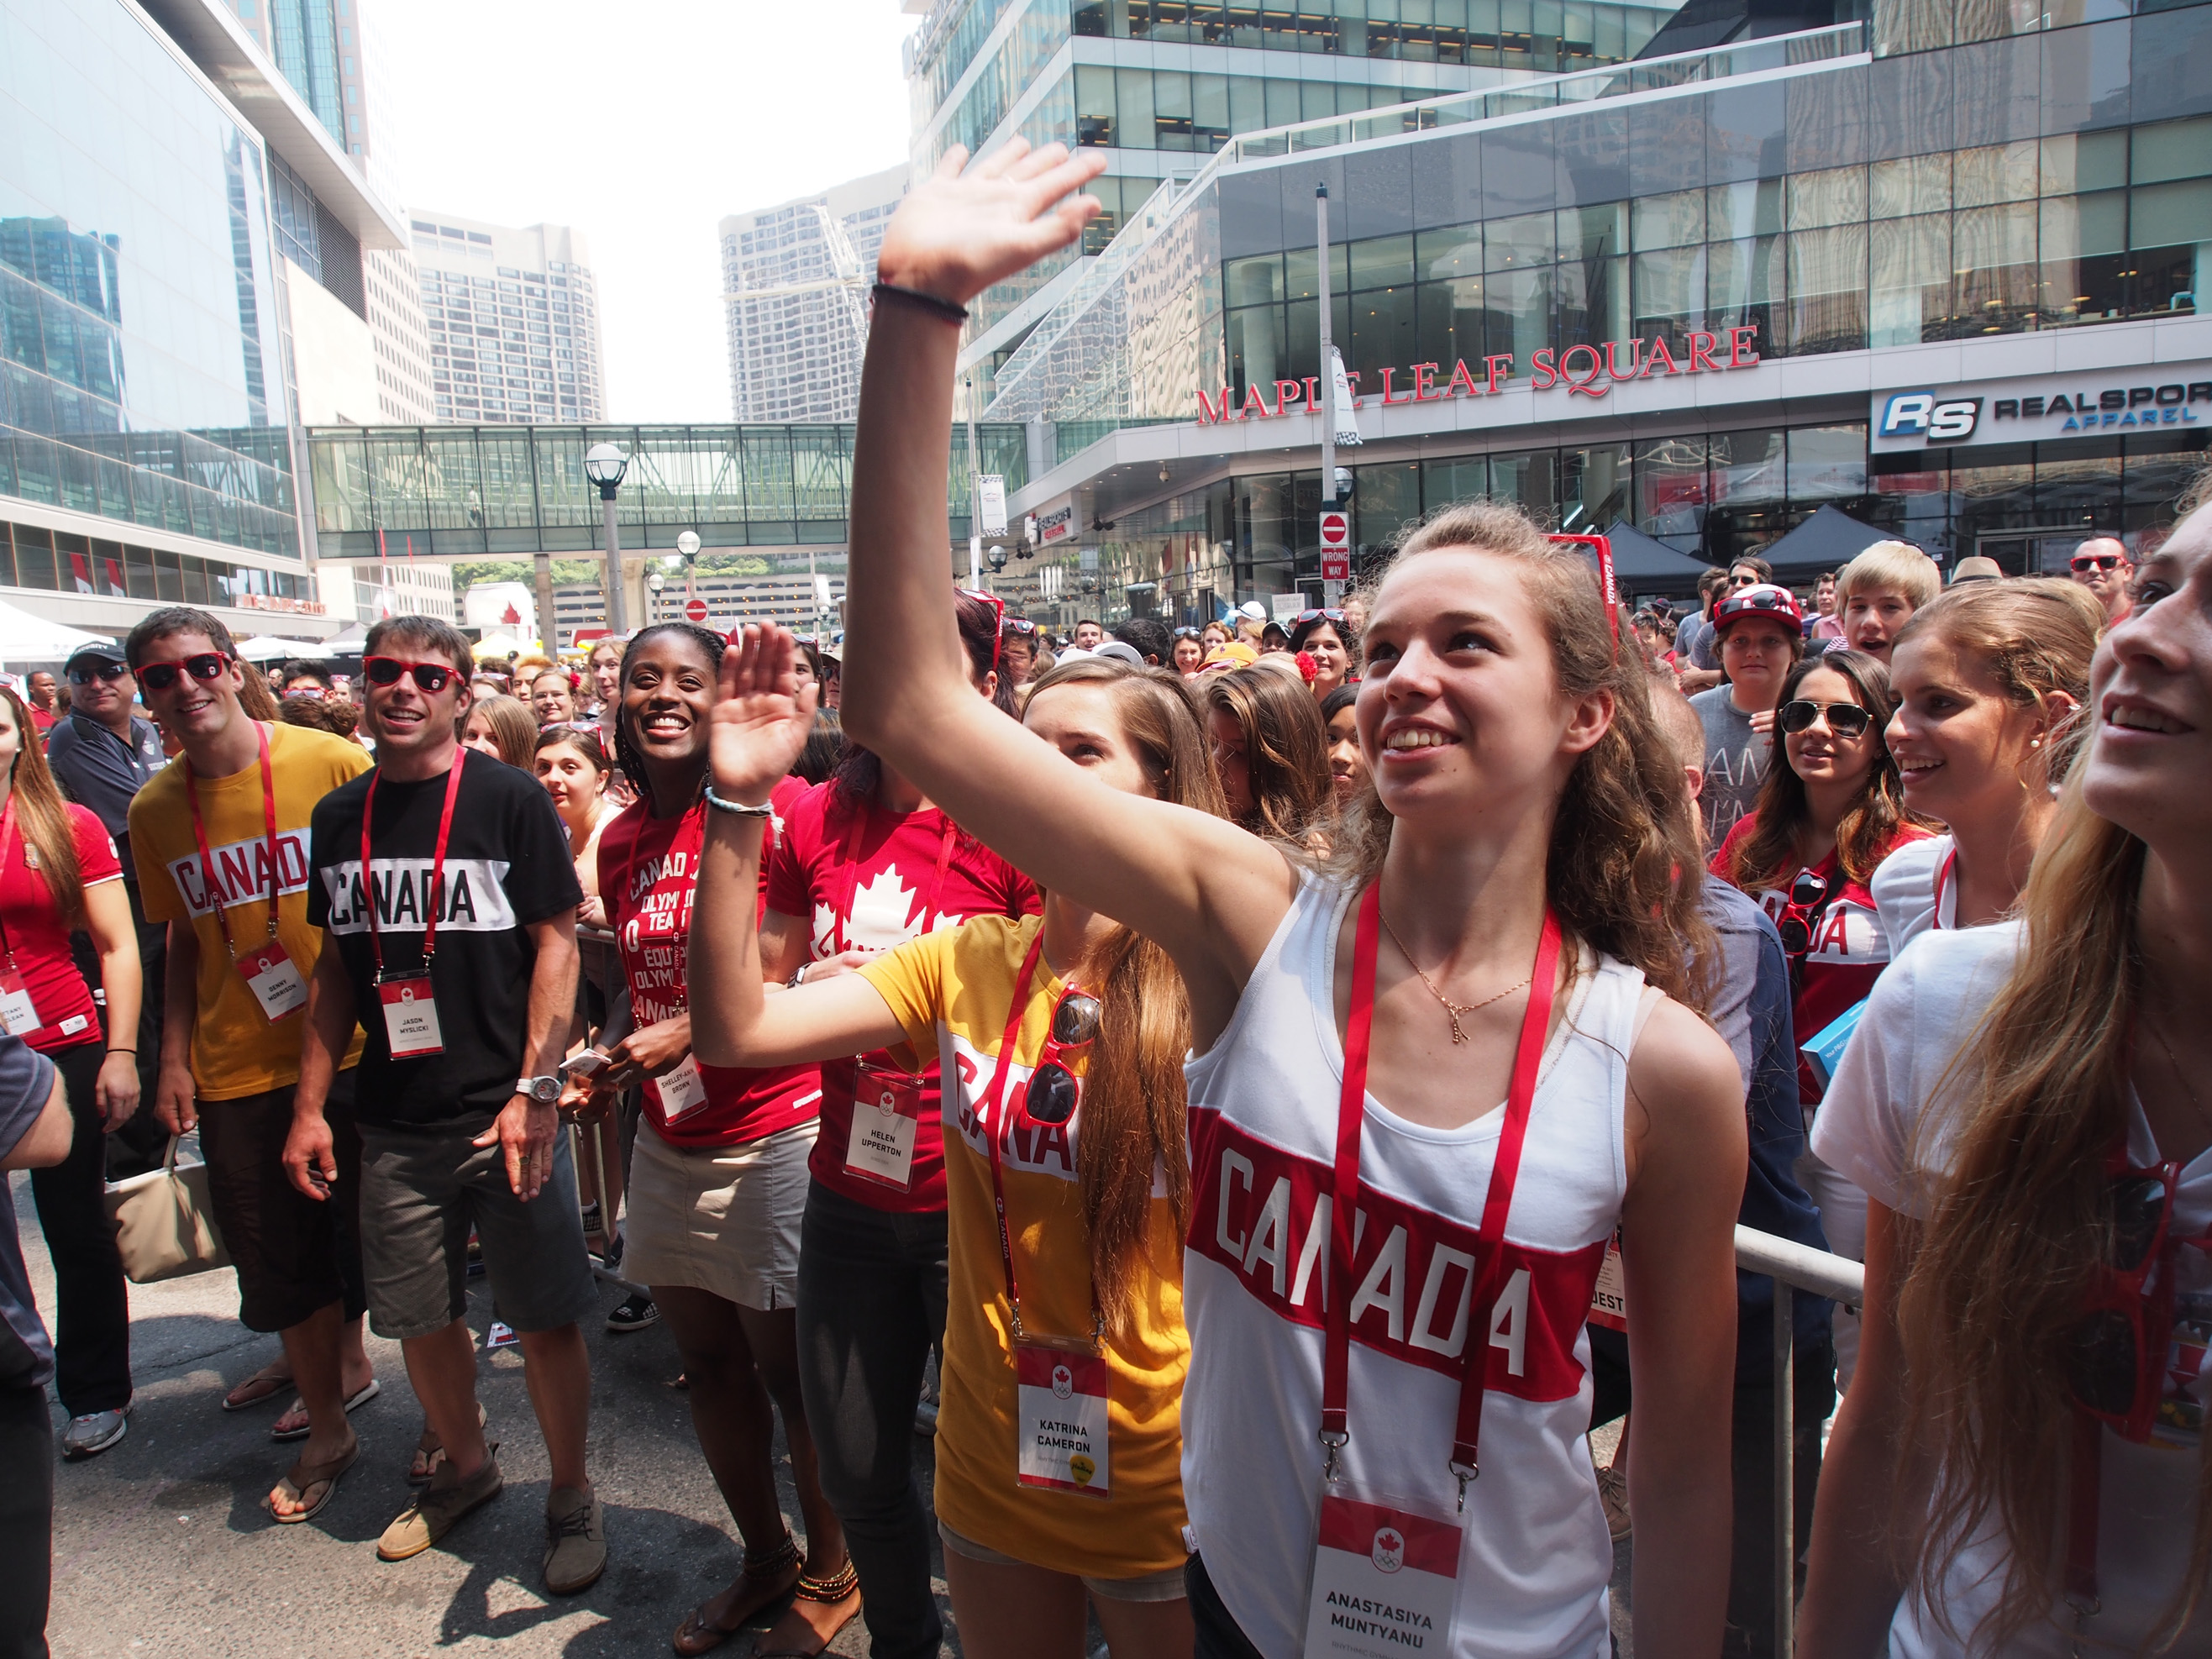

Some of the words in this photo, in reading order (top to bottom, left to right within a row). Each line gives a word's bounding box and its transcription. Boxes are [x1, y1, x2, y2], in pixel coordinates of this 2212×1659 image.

[1379, 354, 1513, 406] LEAF
[1532, 325, 1761, 397] SQUARE
[1884, 393, 1978, 439] RS
[2062, 407, 2199, 431] APPAREL
[1322, 552, 1348, 562] WRONG
[1328, 565, 1342, 576] WAY
[1605, 564, 1616, 604] CANADA
[331, 869, 477, 926] CANADA
[641, 888, 696, 914] OLYMIC
[215, 901, 225, 923] CANADA
[649, 910, 686, 932] TEA
[267, 983, 297, 1001] MORRISON
[268, 979, 287, 992] DENNY
[399, 1025, 429, 1034] MYSLICKI
[402, 1017, 423, 1026] JASON
[1825, 1050, 1836, 1058] Your
[660, 1067, 695, 1089] SHELLEY-ANN
[671, 1079, 691, 1095] BROWN
[954, 1051, 1080, 1173] CANA
[870, 1129, 896, 1143] HELEN
[861, 1138, 901, 1158] UPPERTON
[999, 1218, 1010, 1259] CANADA
[1216, 1147, 1532, 1378] CANADA
[1039, 1419, 1088, 1437] KATRINA
[1038, 1435, 1090, 1453] CAMERON
[1326, 1590, 1433, 1630] ANASTASIYA
[1331, 1613, 1424, 1649] MUNTYANU
[1332, 1641, 1369, 1657] RHYTHMIC
